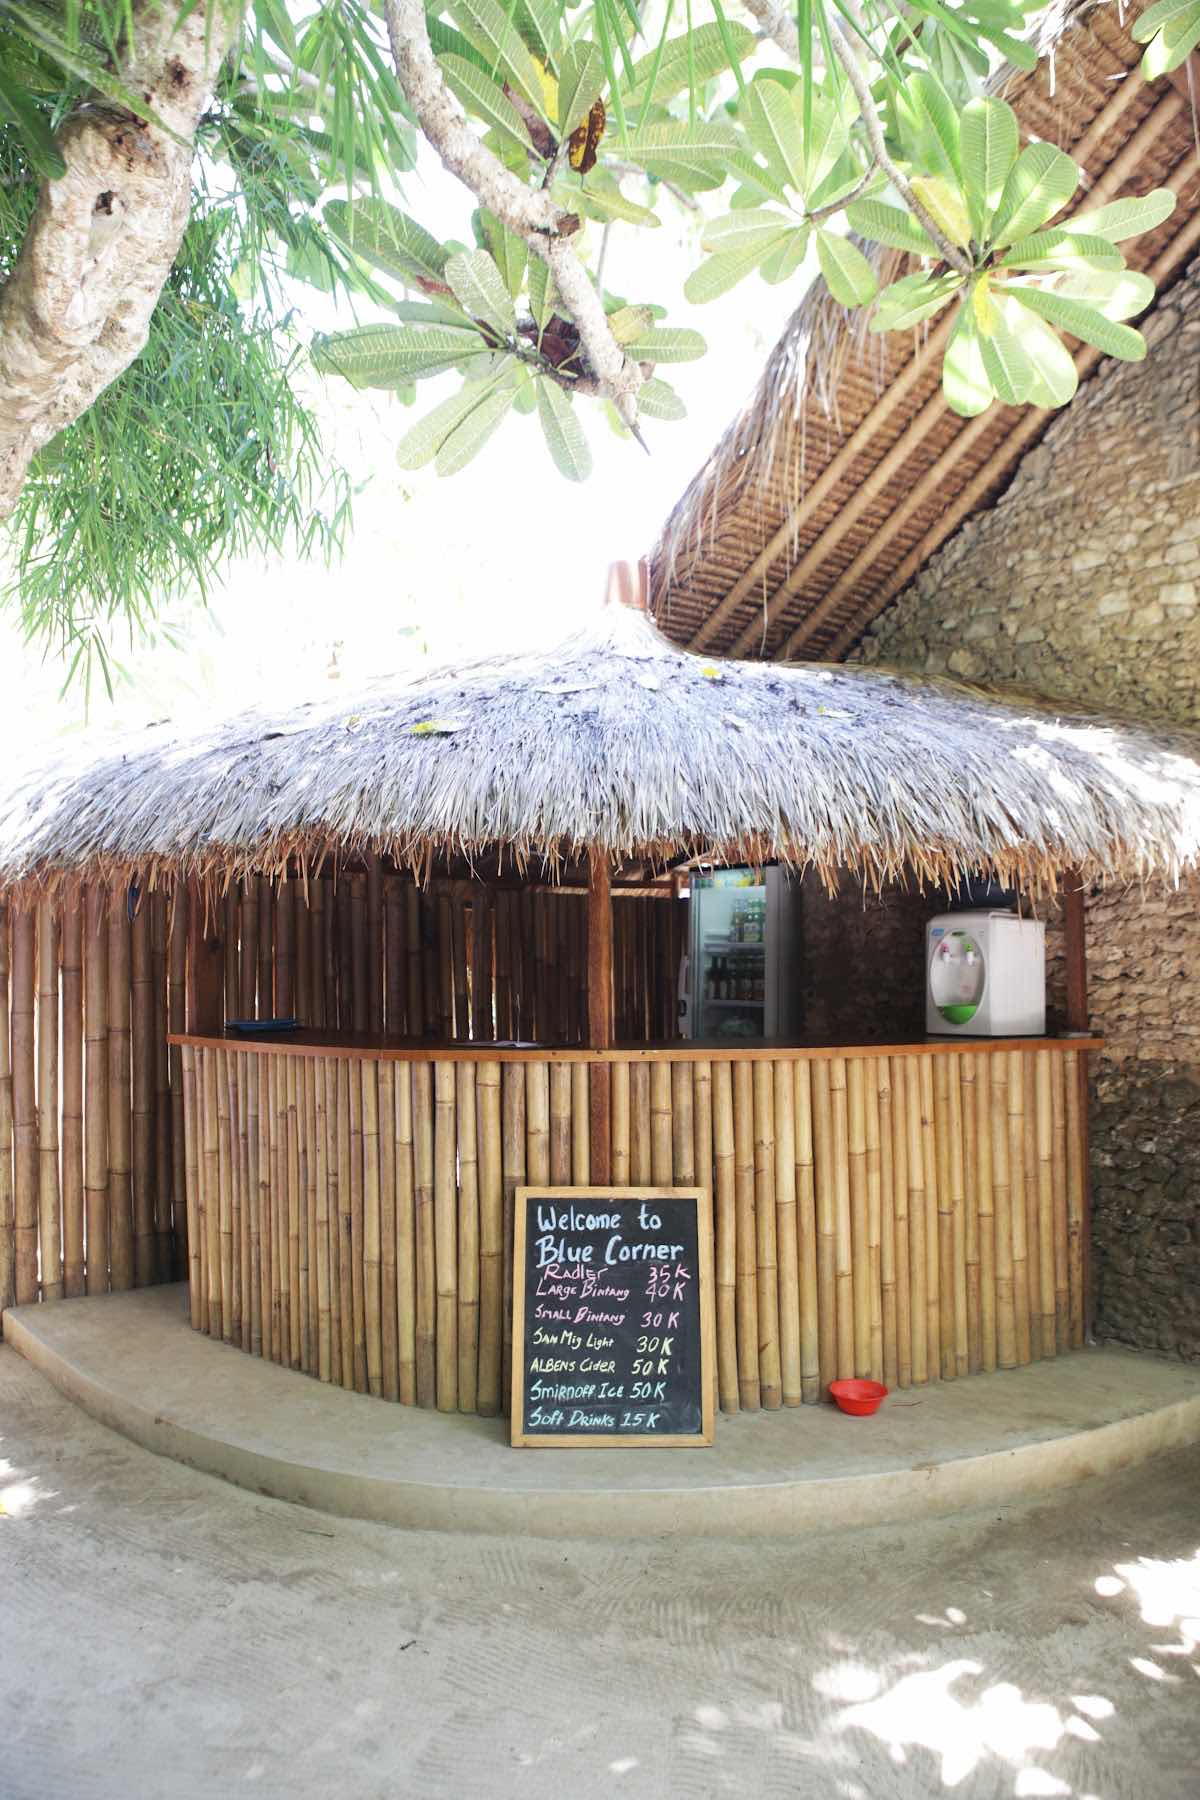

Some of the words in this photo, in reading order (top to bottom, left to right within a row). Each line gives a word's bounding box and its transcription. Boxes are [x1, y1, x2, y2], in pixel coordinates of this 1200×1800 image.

[537, 1204, 621, 1232] Welcome
[638, 1203, 662, 1230] to
[535, 1235, 594, 1268] Blue
[605, 1235, 684, 1265] Corner
[560, 1330, 582, 1349] Mig
[586, 1333, 615, 1350] Light
[530, 1357, 576, 1374] ALBENS
[528, 1406, 565, 1428] Soft
